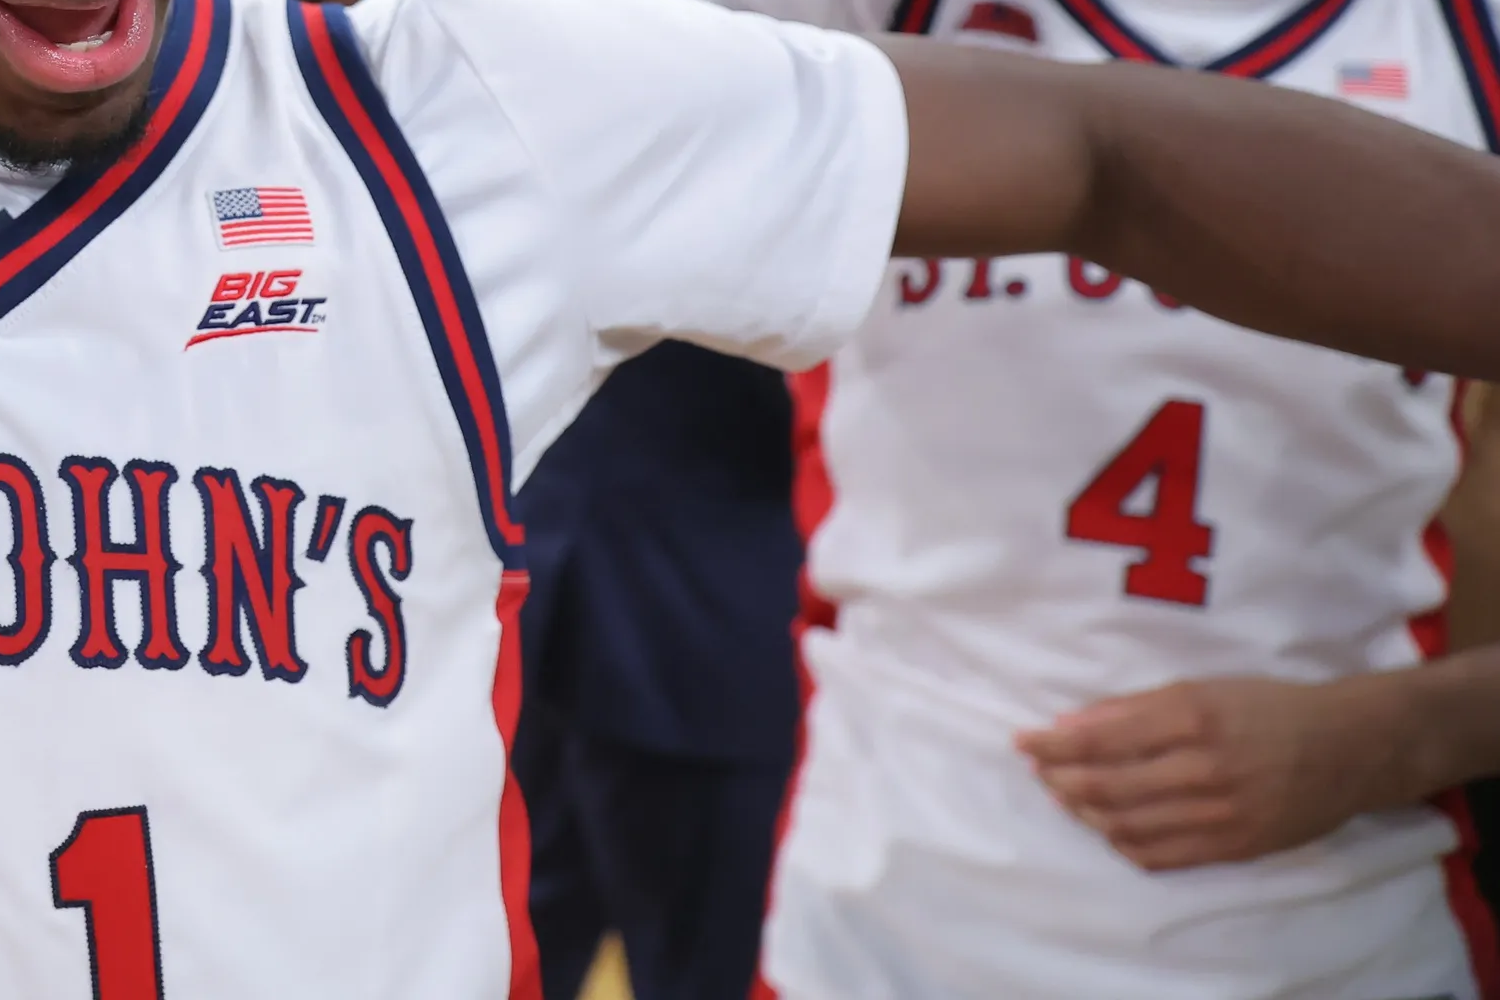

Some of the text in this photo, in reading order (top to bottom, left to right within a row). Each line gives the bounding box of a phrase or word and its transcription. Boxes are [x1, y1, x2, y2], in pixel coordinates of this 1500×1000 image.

[211, 269, 303, 302] BIG
[197, 297, 327, 331] EAST
[1065, 398, 1215, 607] 4
